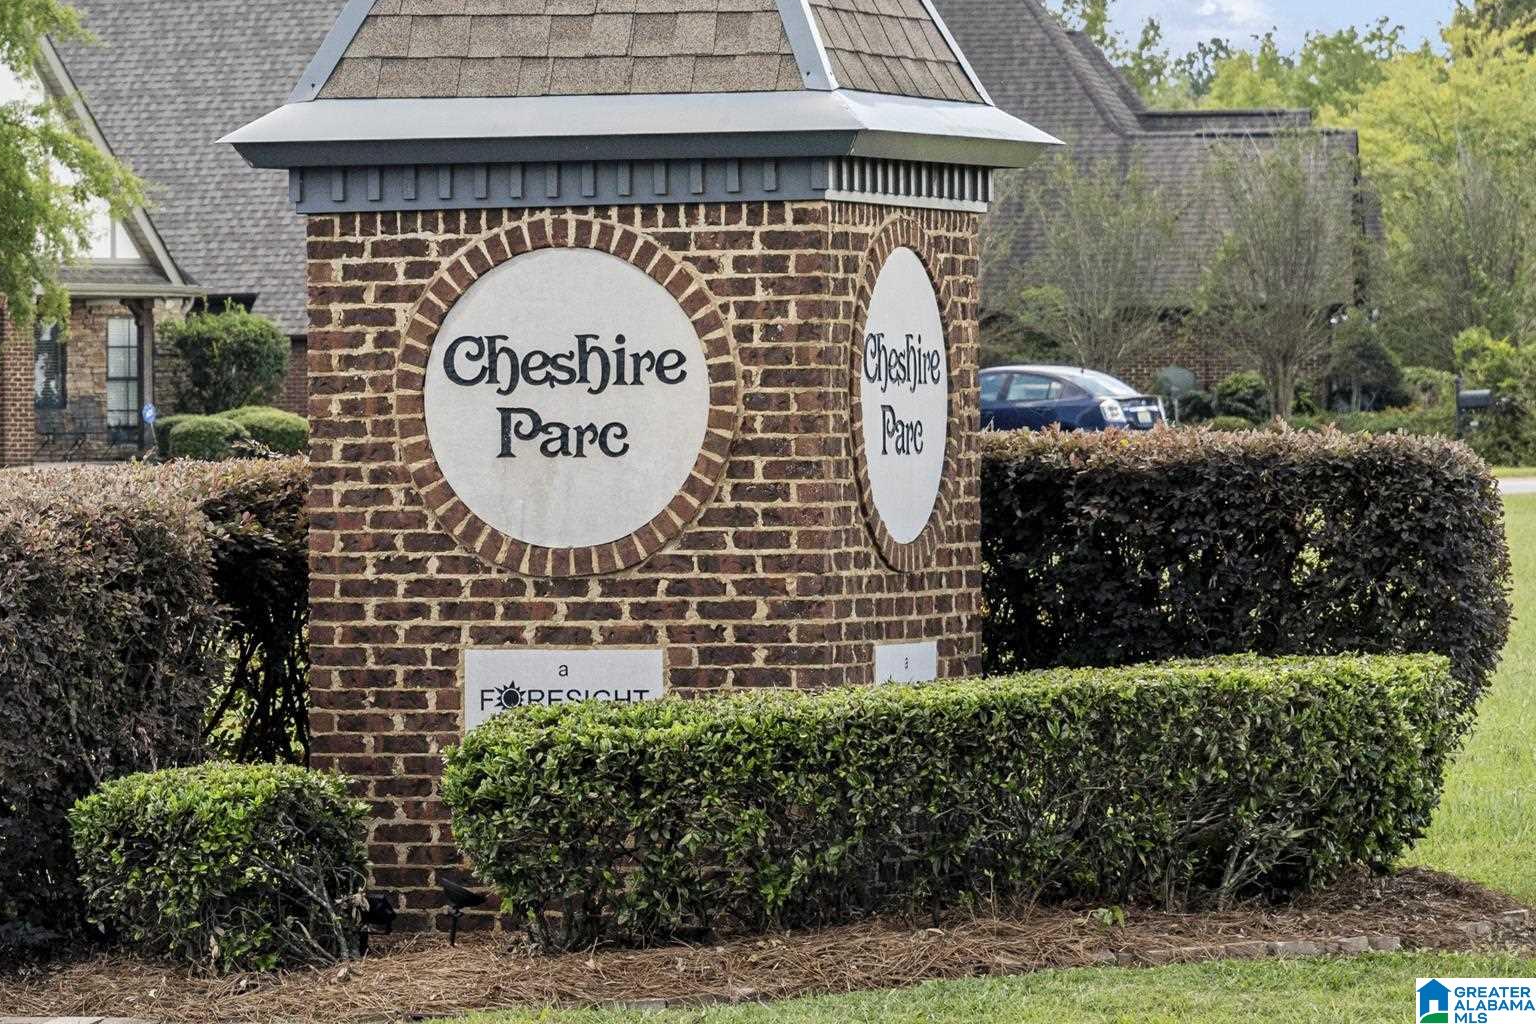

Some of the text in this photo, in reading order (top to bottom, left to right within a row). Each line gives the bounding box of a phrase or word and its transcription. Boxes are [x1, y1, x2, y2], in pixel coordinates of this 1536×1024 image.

[443, 333, 688, 395] Cheshire
[864, 332, 941, 393] Cheshire
[496, 406, 630, 458] Parc
[881, 404, 923, 455] Parc
[558, 664, 569, 677] a
